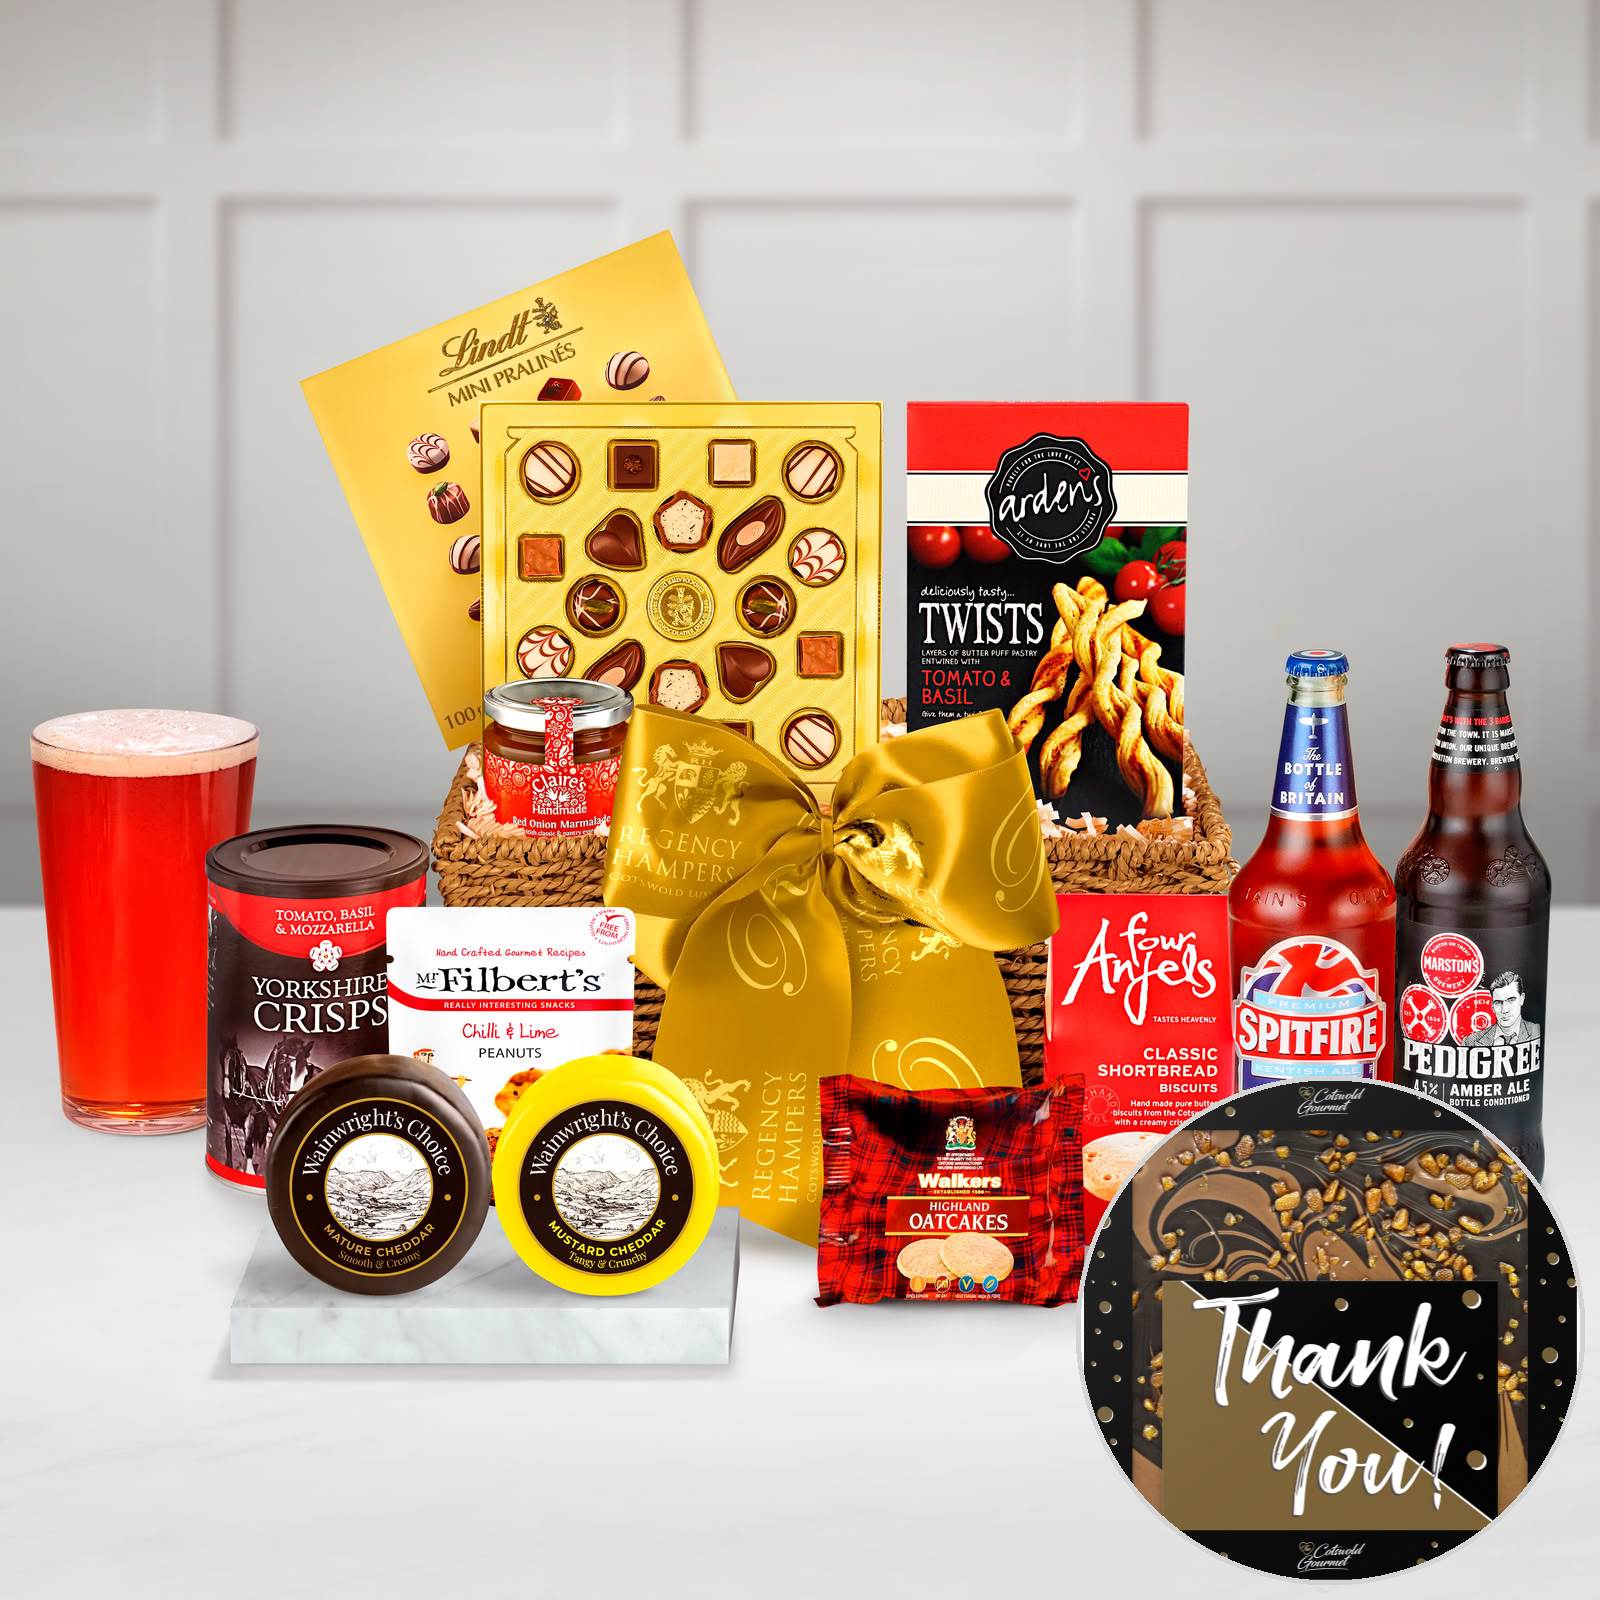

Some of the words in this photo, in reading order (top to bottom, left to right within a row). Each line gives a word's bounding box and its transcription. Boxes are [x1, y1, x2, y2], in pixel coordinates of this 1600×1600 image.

[439, 309, 533, 377] Lindt
[448, 377, 492, 407] MINI
[494, 343, 576, 388] PRALINÉS
[920, 586, 975, 601] deliciously
[919, 603, 1044, 644] TWISTS
[921, 670, 996, 686] TOMATO
[1000, 671, 1011, 686] &
[922, 688, 974, 704] BASIL
[1454, 717, 1472, 726] WITH
[1474, 718, 1488, 726] THE
[1446, 728, 1456, 737] THE
[1458, 730, 1480, 738] TOWN.
[1492, 730, 1499, 738] IS
[1302, 747, 1322, 761] The
[1459, 743, 1472, 752] OUR
[1474, 743, 1500, 752] UNIQUE
[1454, 757, 1488, 766] BREWERY.
[1490, 754, 1512, 764] BREWING
[1284, 762, 1342, 776] BOTTLE
[532, 772, 586, 792] Claire's
[1304, 777, 1316, 791] of
[1280, 792, 1344, 805] BRITAIN
[532, 801, 587, 815] Handmade
[512, 816, 528, 826] Red
[530, 820, 556, 829] Onion
[560, 814, 611, 829] Marmalade
[620, 825, 742, 860] REGENCY
[612, 848, 735, 884] HAMPERS
[608, 872, 684, 896] COTSWOLD
[276, 910, 338, 924] TOMATO,
[340, 906, 376, 918] BASIL
[275, 924, 286, 934] &
[290, 920, 374, 936] MOZZARELLA
[596, 928, 618, 939] FROM
[600, 922, 620, 932] FREE
[1120, 912, 1196, 967] four
[436, 948, 458, 957] Hand
[461, 948, 502, 957] Crafted
[504, 948, 543, 957] Gourmet
[546, 948, 586, 961] Recipes
[1424, 956, 1480, 974] MARSTON'S
[252, 972, 388, 999] YORKSHIRE
[438, 966, 602, 992] Filbert's
[1434, 976, 1466, 989] BREWERY
[1267, 998, 1351, 1010] PREMIUM
[253, 995, 388, 1034] CRISPS
[462, 1022, 500, 1040] Chilli
[506, 1022, 514, 1040] &
[520, 1023, 560, 1040] Lime
[1239, 1008, 1378, 1055] SPITFIRE
[478, 1048, 542, 1059] PEANUTS
[1143, 1048, 1218, 1061] CLASSIC
[1402, 1036, 1540, 1080] PEDIGREE
[1098, 1064, 1218, 1078] SHORTBREAD
[1254, 1064, 1325, 1075] KENTISH
[1332, 1063, 1361, 1075] ALE
[1160, 1084, 1218, 1093] BISCUITS
[1450, 1084, 1502, 1097] AMBER
[1507, 1078, 1530, 1095] ALE
[1090, 1087, 1118, 1108] HAND
[1313, 1088, 1366, 1104] Cotswold
[1450, 1098, 1480, 1107] BOTTLE
[1484, 1094, 1530, 1106] CONDITIONED
[1297, 1100, 1352, 1116] Gourmet
[302, 1108, 405, 1176] Wainwright's
[407, 1119, 451, 1176] Choice
[530, 1108, 632, 1176] Wainwright's
[634, 1118, 678, 1176] Choice
[752, 1071, 782, 1200] REGENCY
[778, 1072, 808, 1204] HAMPERS
[806, 1128, 822, 1204] COTSWOLD
[918, 1173, 1002, 1188] Walkers
[929, 1202, 990, 1212] HIGHLAND
[909, 1213, 1008, 1231] OATCAKES
[323, 1224, 372, 1258] MATURE
[376, 1223, 436, 1258] CHEDDAR
[548, 1220, 606, 1258] MUSTARD
[609, 1218, 666, 1258] CHEDDAR
[338, 1250, 374, 1270] Smooth
[375, 1259, 386, 1270] &
[386, 1250, 422, 1270] Creamy
[568, 1250, 596, 1270] Tangy
[598, 1259, 606, 1270] &
[608, 1250, 648, 1270] Crunchy
[1193, 1287, 1466, 1406] Thank
[1261, 1410, 1456, 1517] You!
[1313, 1543, 1366, 1558] Cotswold
[1297, 1555, 1352, 1570] Gourmet
